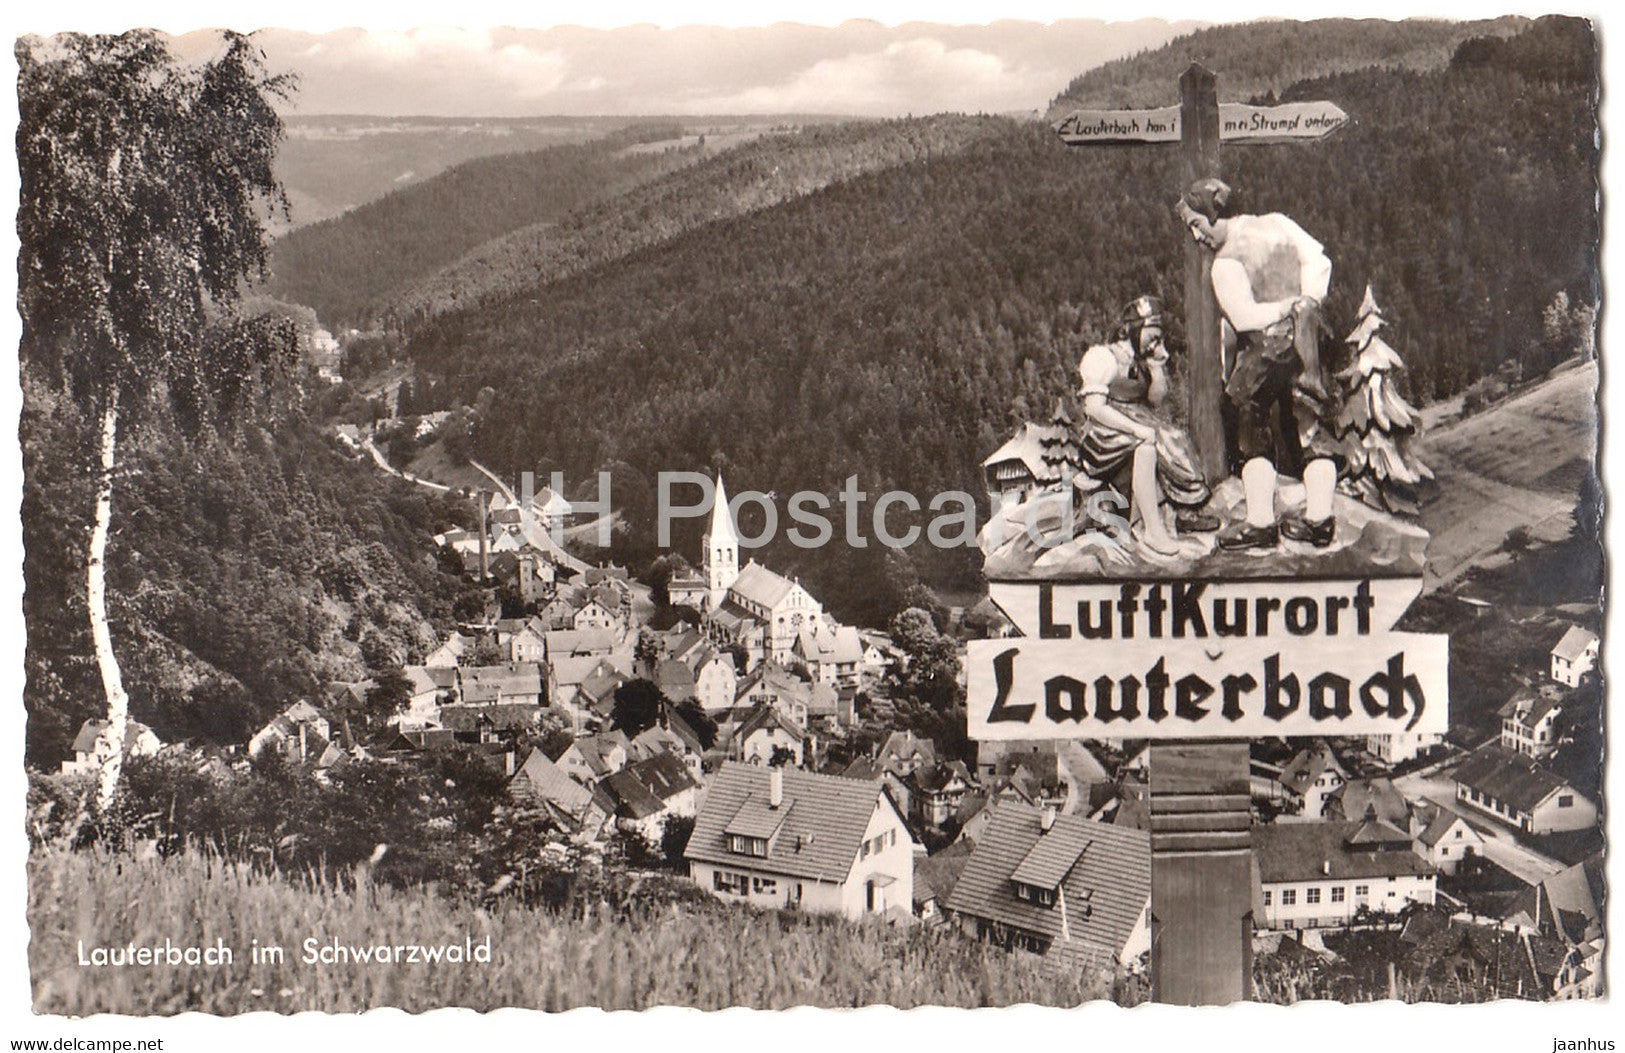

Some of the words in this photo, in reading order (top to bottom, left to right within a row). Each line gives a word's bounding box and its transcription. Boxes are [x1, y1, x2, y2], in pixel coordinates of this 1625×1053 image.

[1146, 118, 1166, 132] han
[1171, 118, 1176, 132] i
[1250, 112, 1301, 132] Strumpf
[986, 647, 1426, 731] Lauterbach
